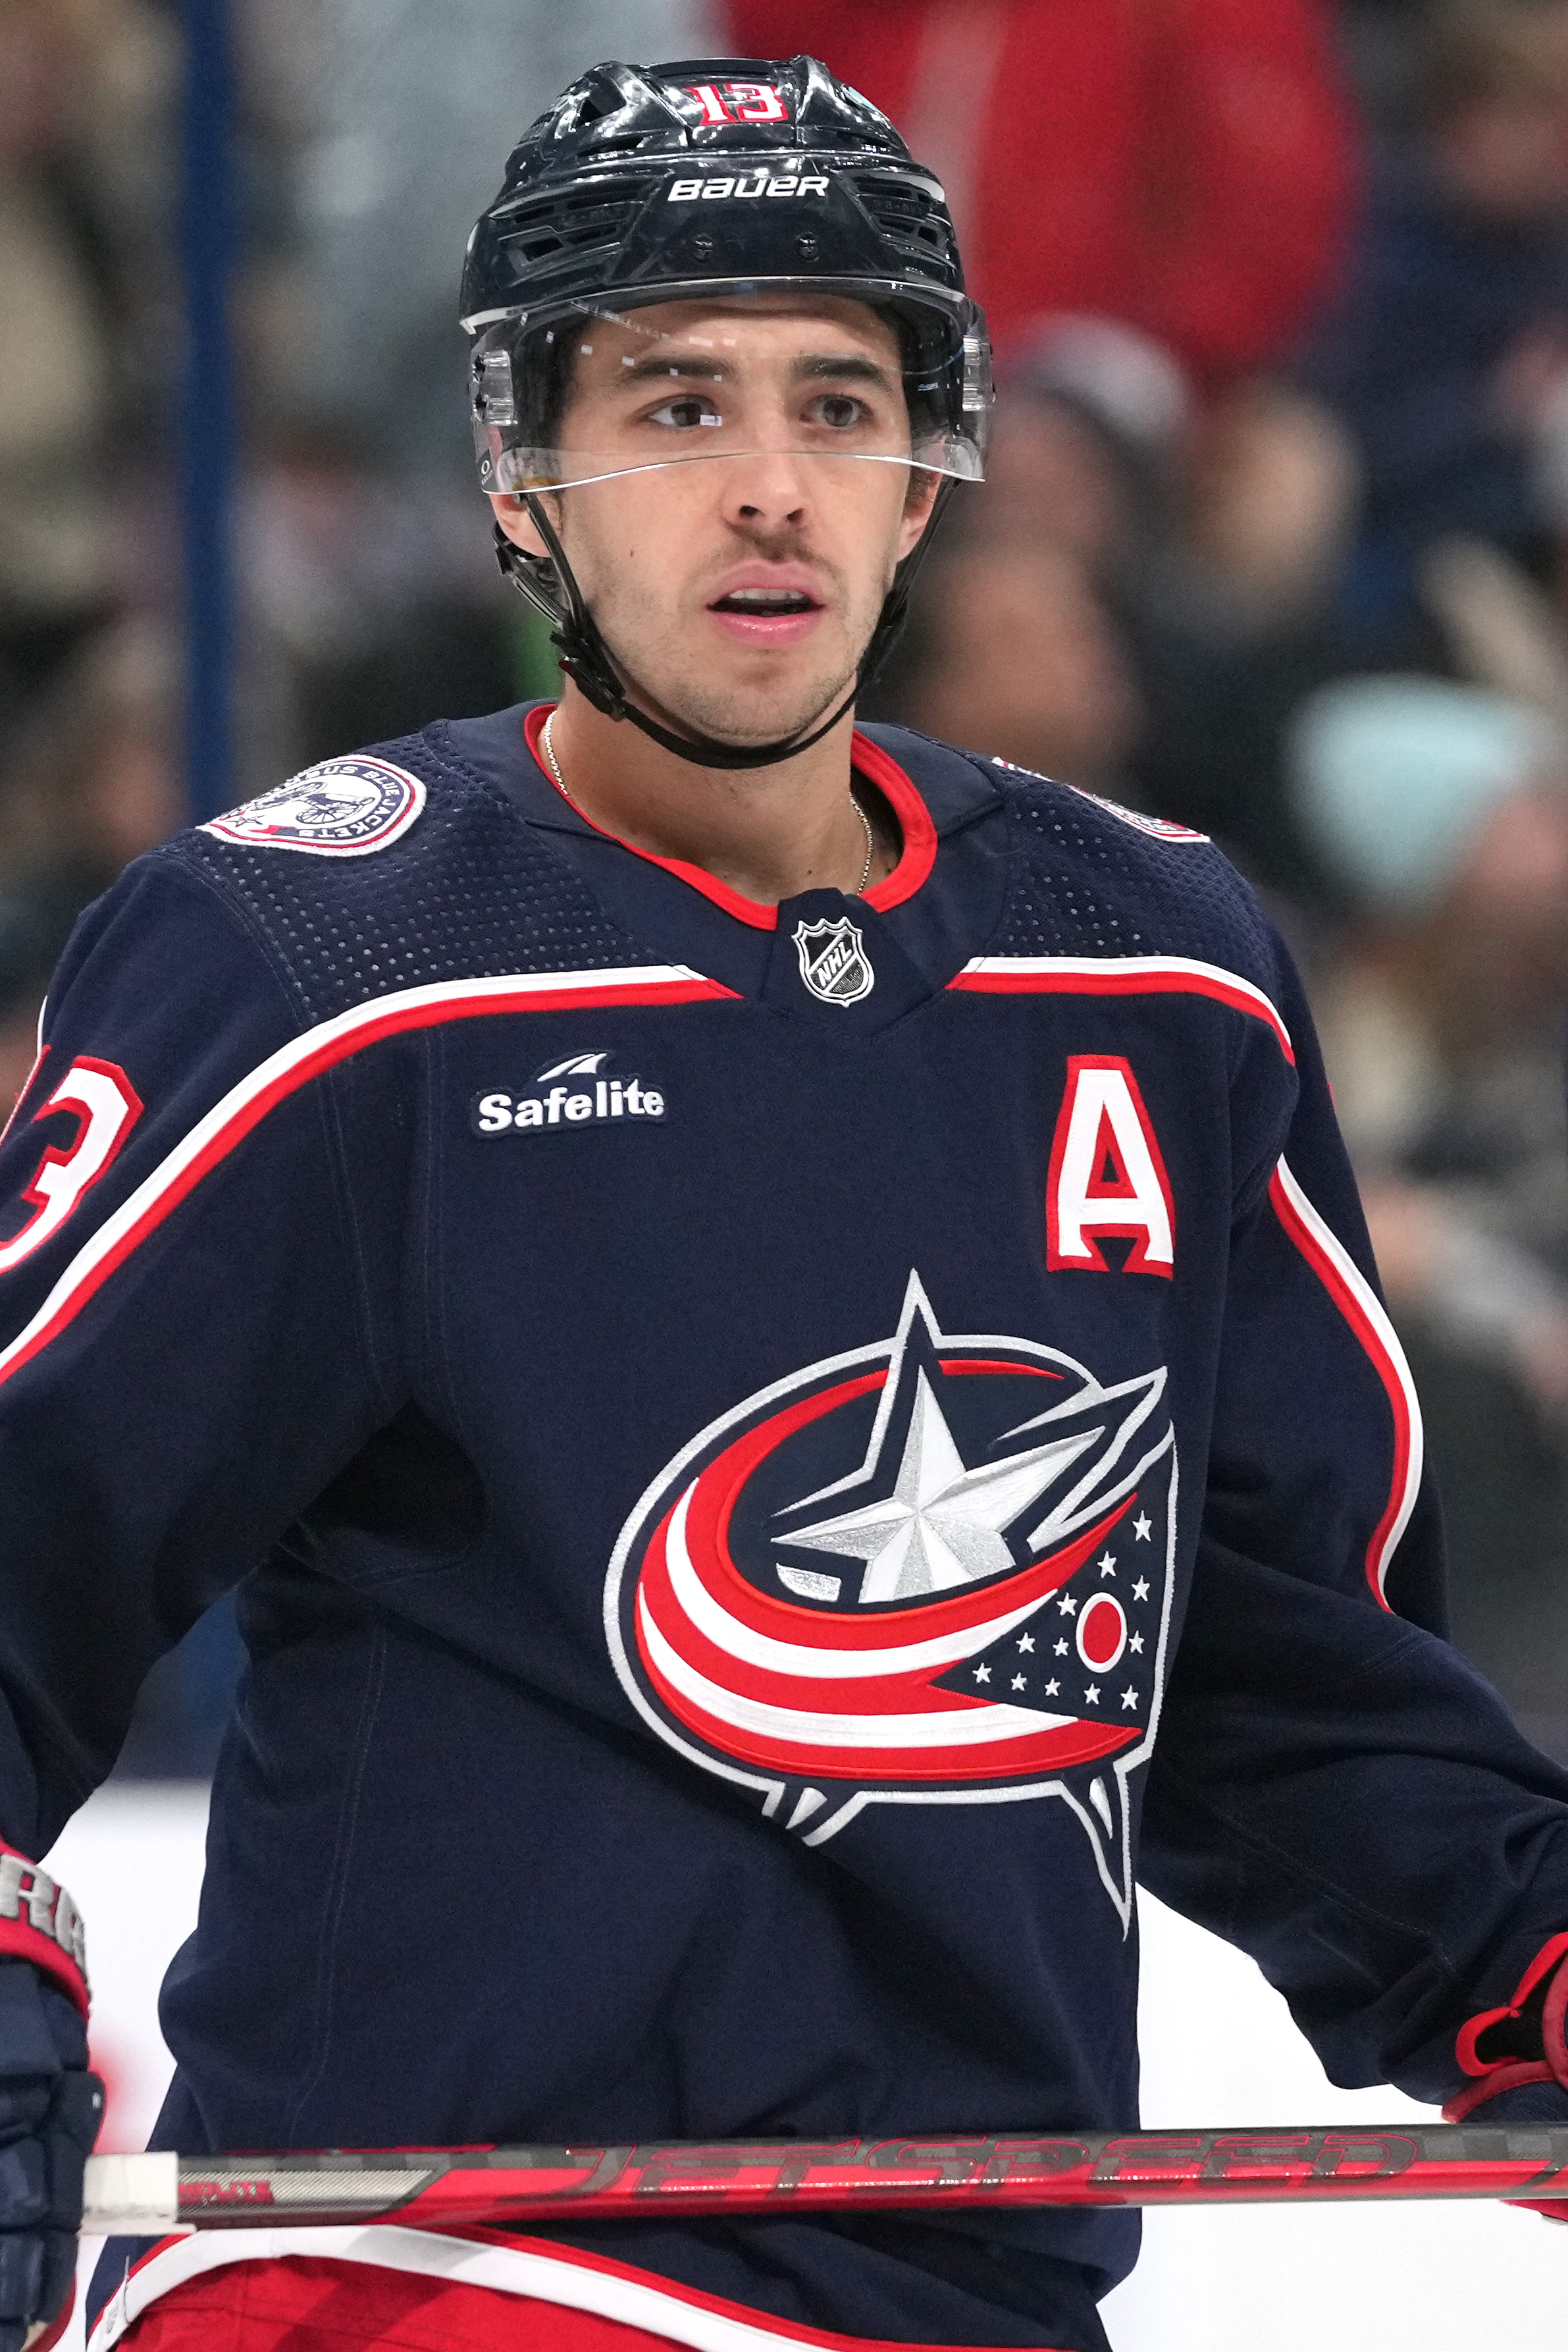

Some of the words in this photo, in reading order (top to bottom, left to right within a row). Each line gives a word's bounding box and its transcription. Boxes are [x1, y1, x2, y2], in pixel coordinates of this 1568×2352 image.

[685, 83, 789, 126] 13
[667, 175, 829, 201] BAUER
[362, 770, 400, 797] BLUE
[298, 798, 396, 838] JACKETS
[816, 941, 852, 987] NHL
[479, 1079, 666, 1132] Safelite
[1045, 1054, 1176, 1280] A
[494, 2133, 1418, 2203] JETSPEED
